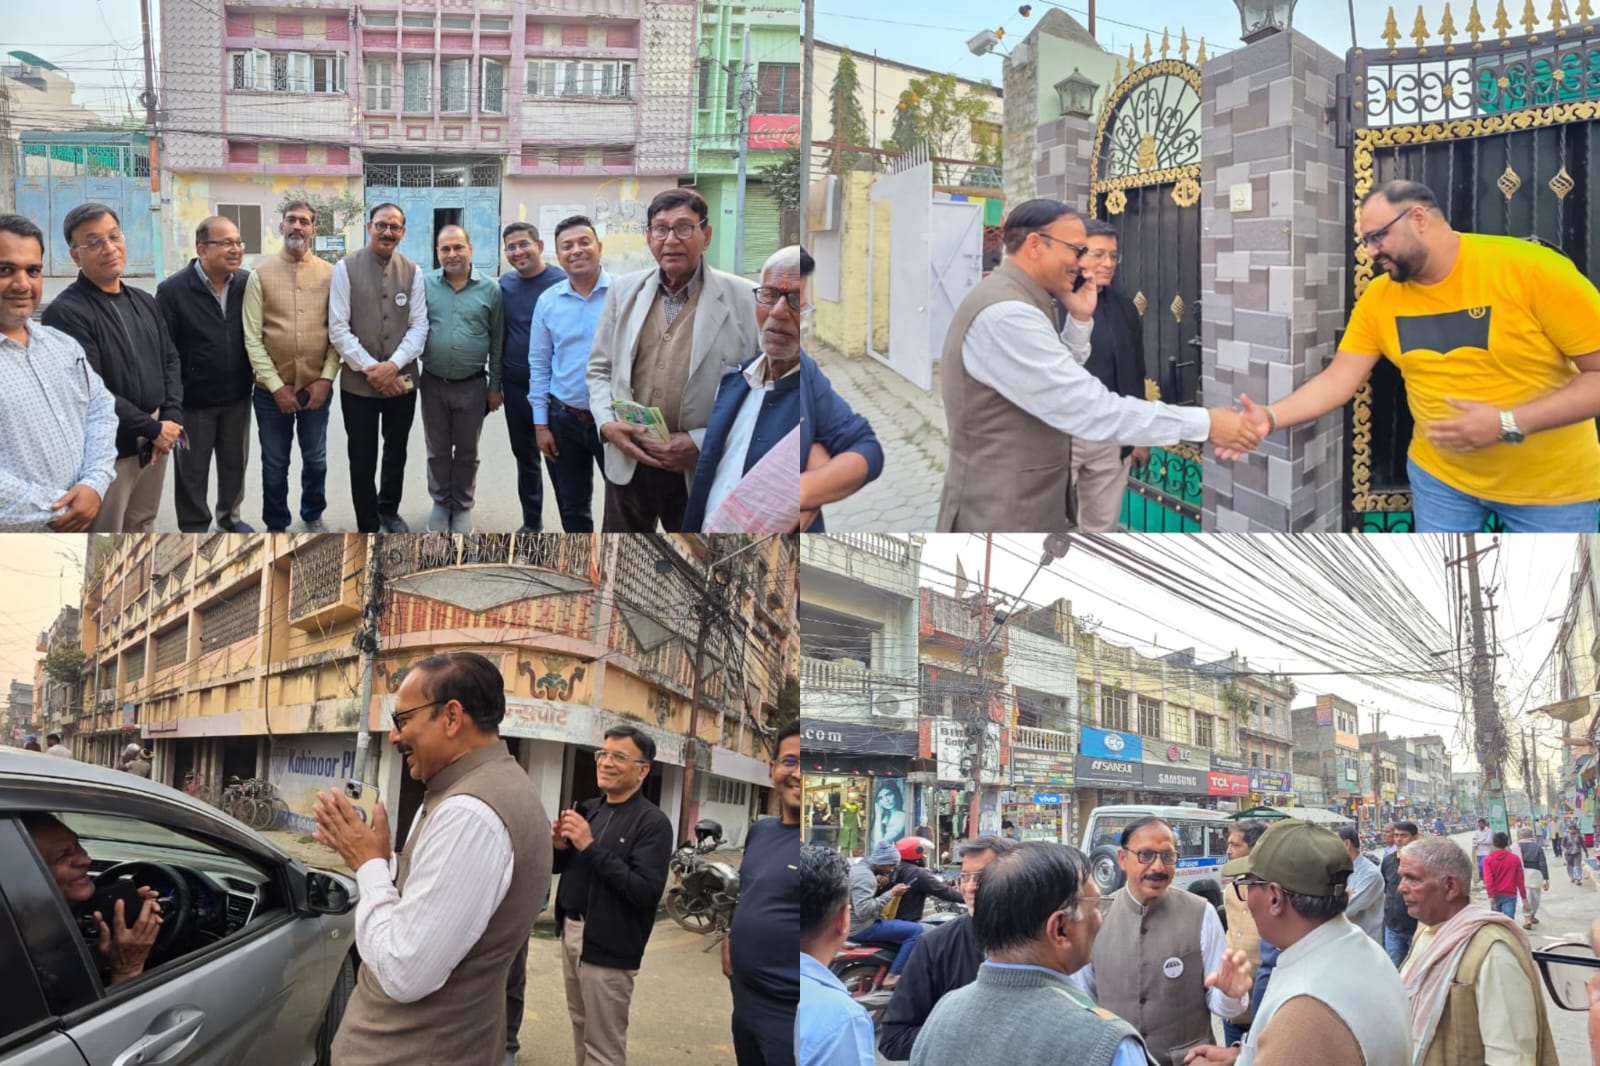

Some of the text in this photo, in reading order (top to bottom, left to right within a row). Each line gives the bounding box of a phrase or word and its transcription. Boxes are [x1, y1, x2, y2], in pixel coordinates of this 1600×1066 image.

[1102, 761, 1132, 773] SANSUI
[1158, 773, 1197, 786] SAMSUNG
[1210, 776, 1229, 788] TCL
